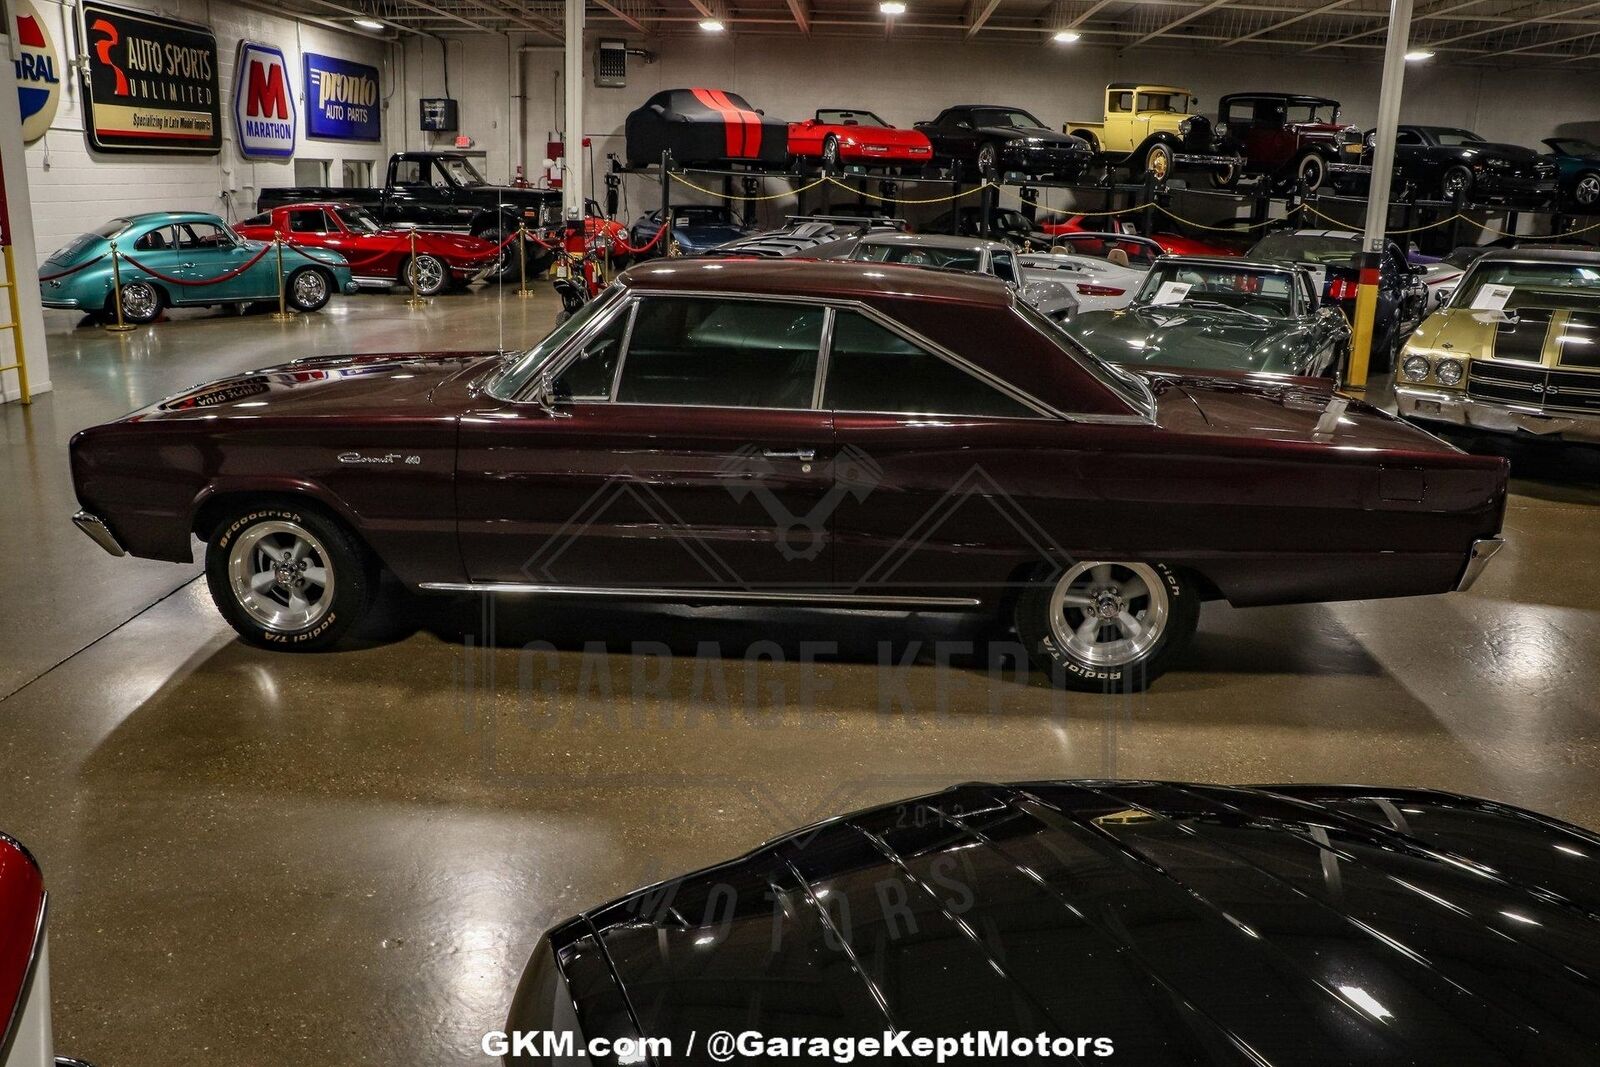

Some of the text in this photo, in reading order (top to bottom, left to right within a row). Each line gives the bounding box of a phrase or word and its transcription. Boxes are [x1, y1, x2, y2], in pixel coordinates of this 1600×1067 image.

[127, 36, 211, 80] AUTO SPORTS
[129, 78, 211, 105] UNLIMITED
[246, 59, 288, 119] M
[319, 70, 377, 109] pronto
[133, 113, 163, 130] Specializing
[325, 104, 368, 123] AUTO PARTS
[246, 120, 291, 139] MARATHON
[1532, 382, 1558, 394] SS
[293, 612, 337, 643] Radial
[1062, 661, 1122, 680] Radial
